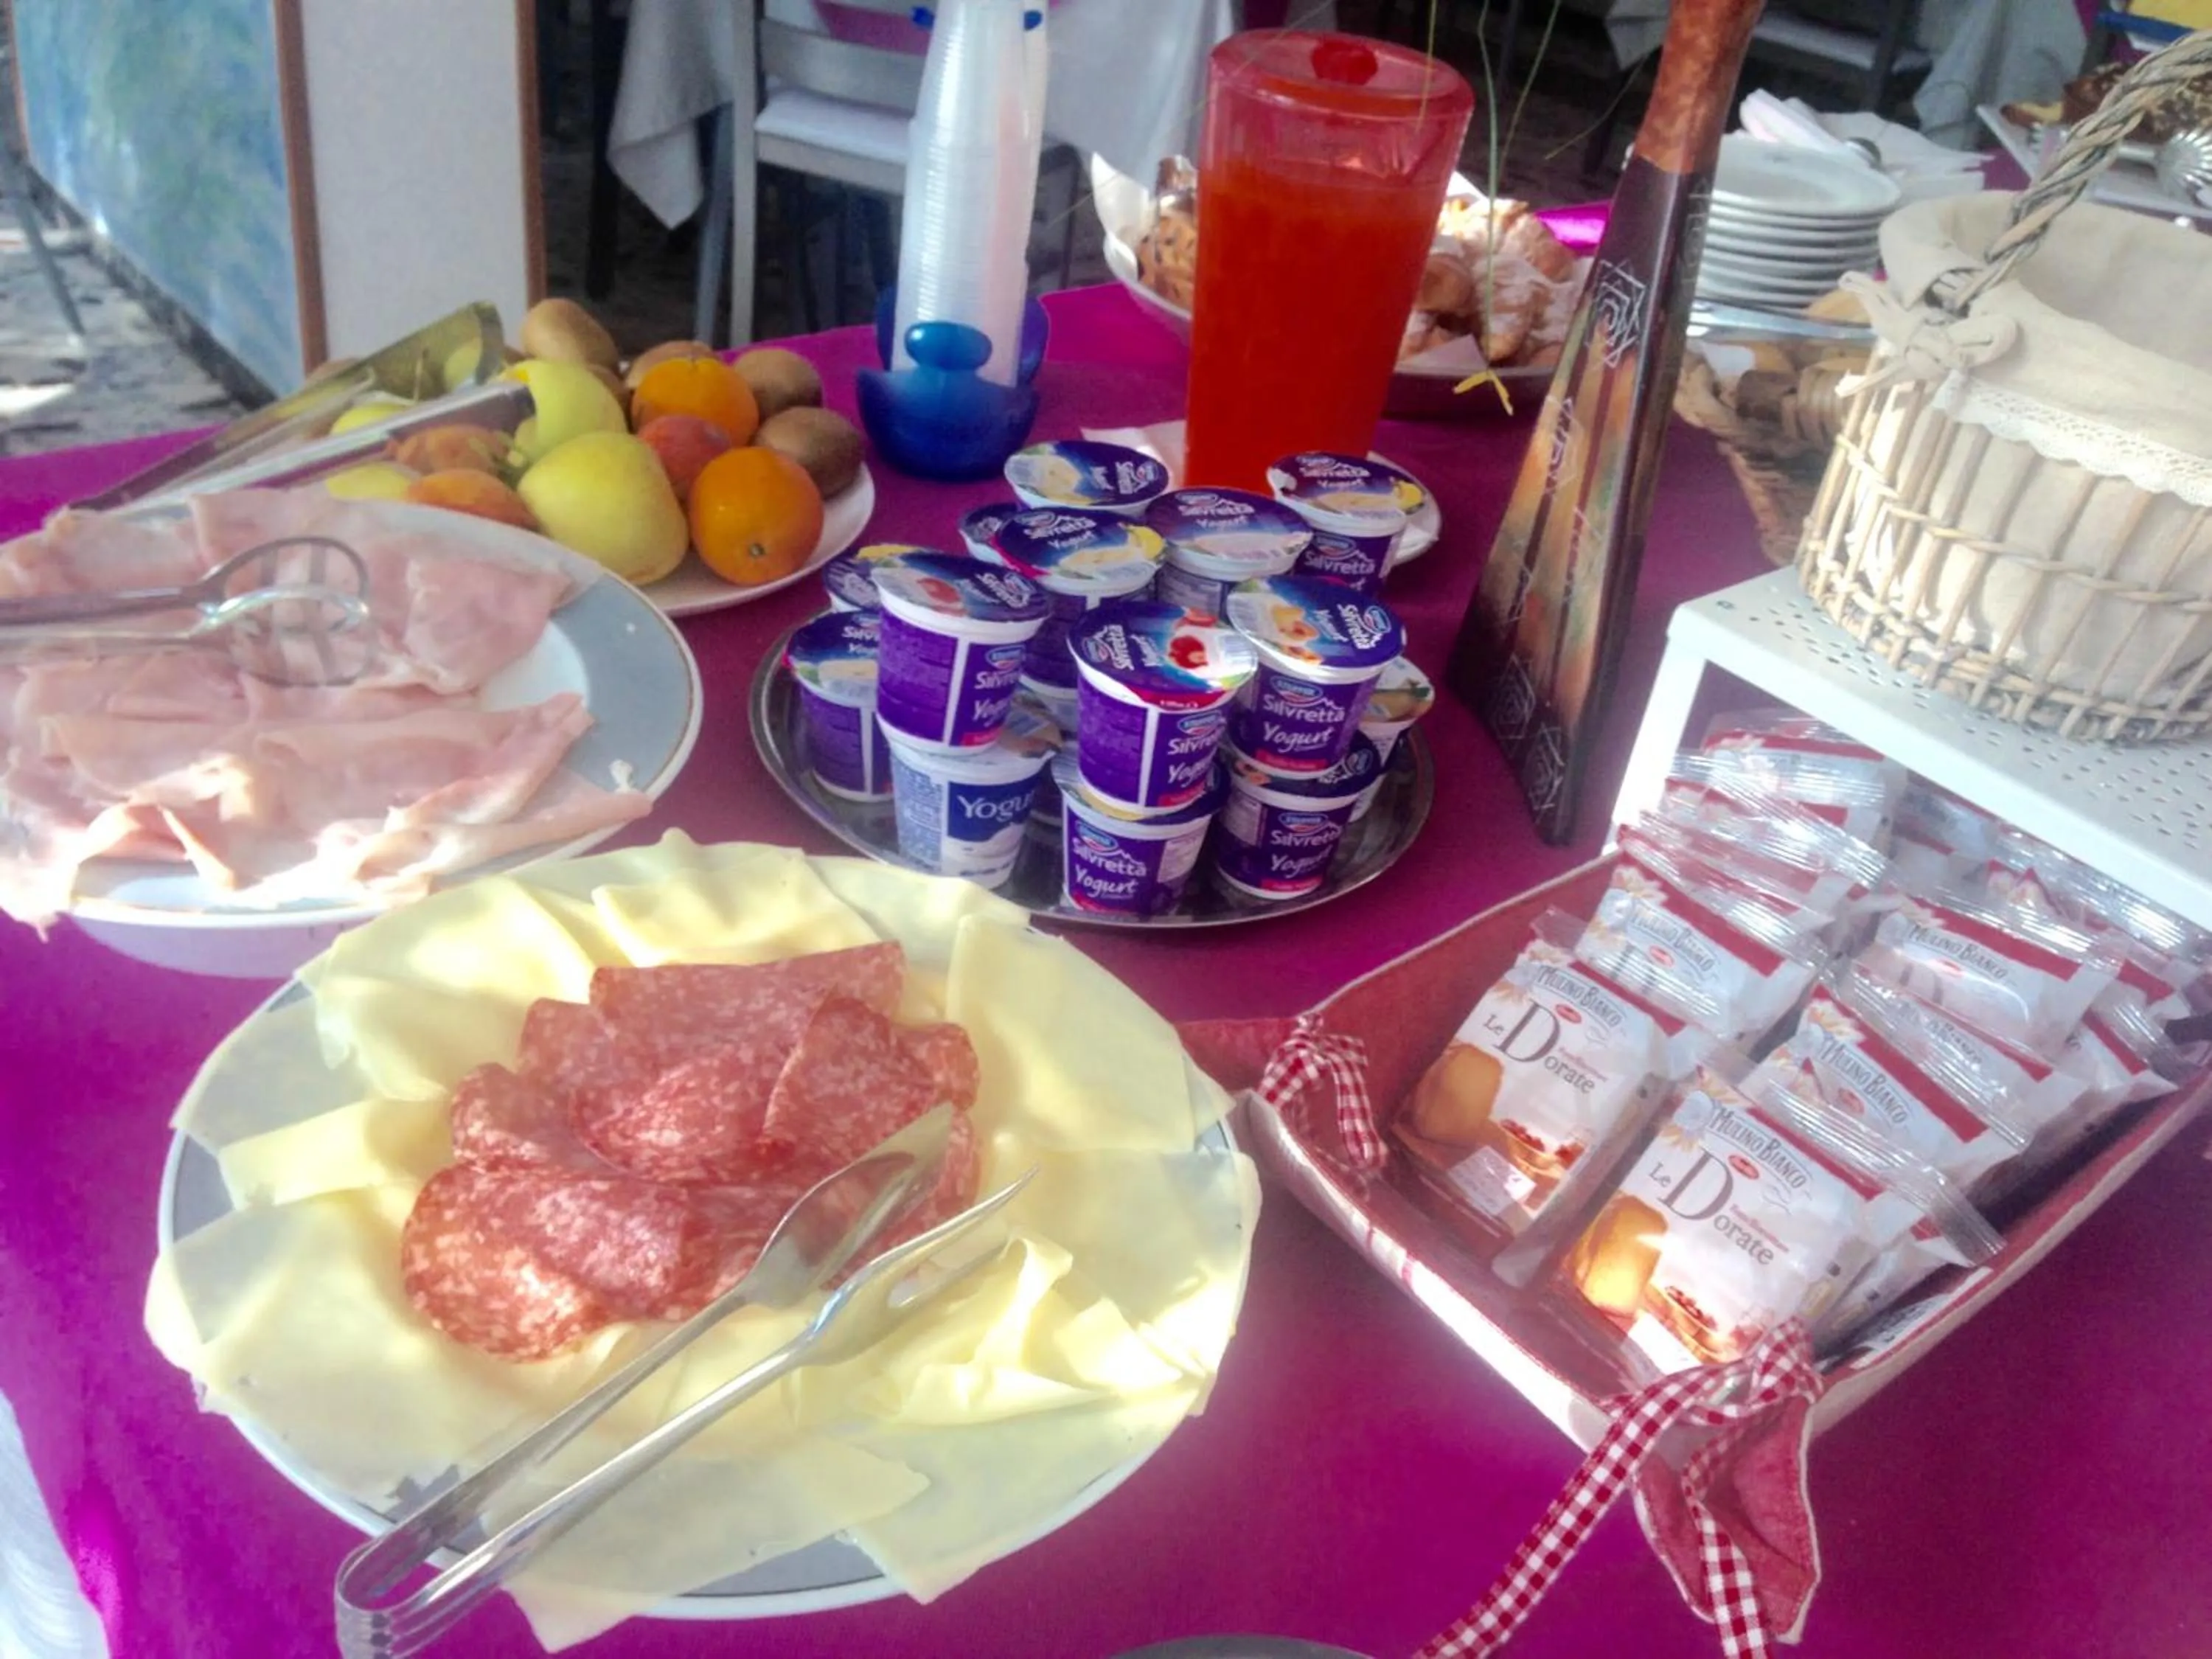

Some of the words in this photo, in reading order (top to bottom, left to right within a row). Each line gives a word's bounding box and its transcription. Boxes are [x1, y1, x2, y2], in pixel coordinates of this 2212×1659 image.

[1263, 694, 1346, 723] Silvretta
[1263, 721, 1335, 753] Yogurt
[957, 790, 1034, 823] Yogu
[1075, 863, 1139, 898] Yogurt
